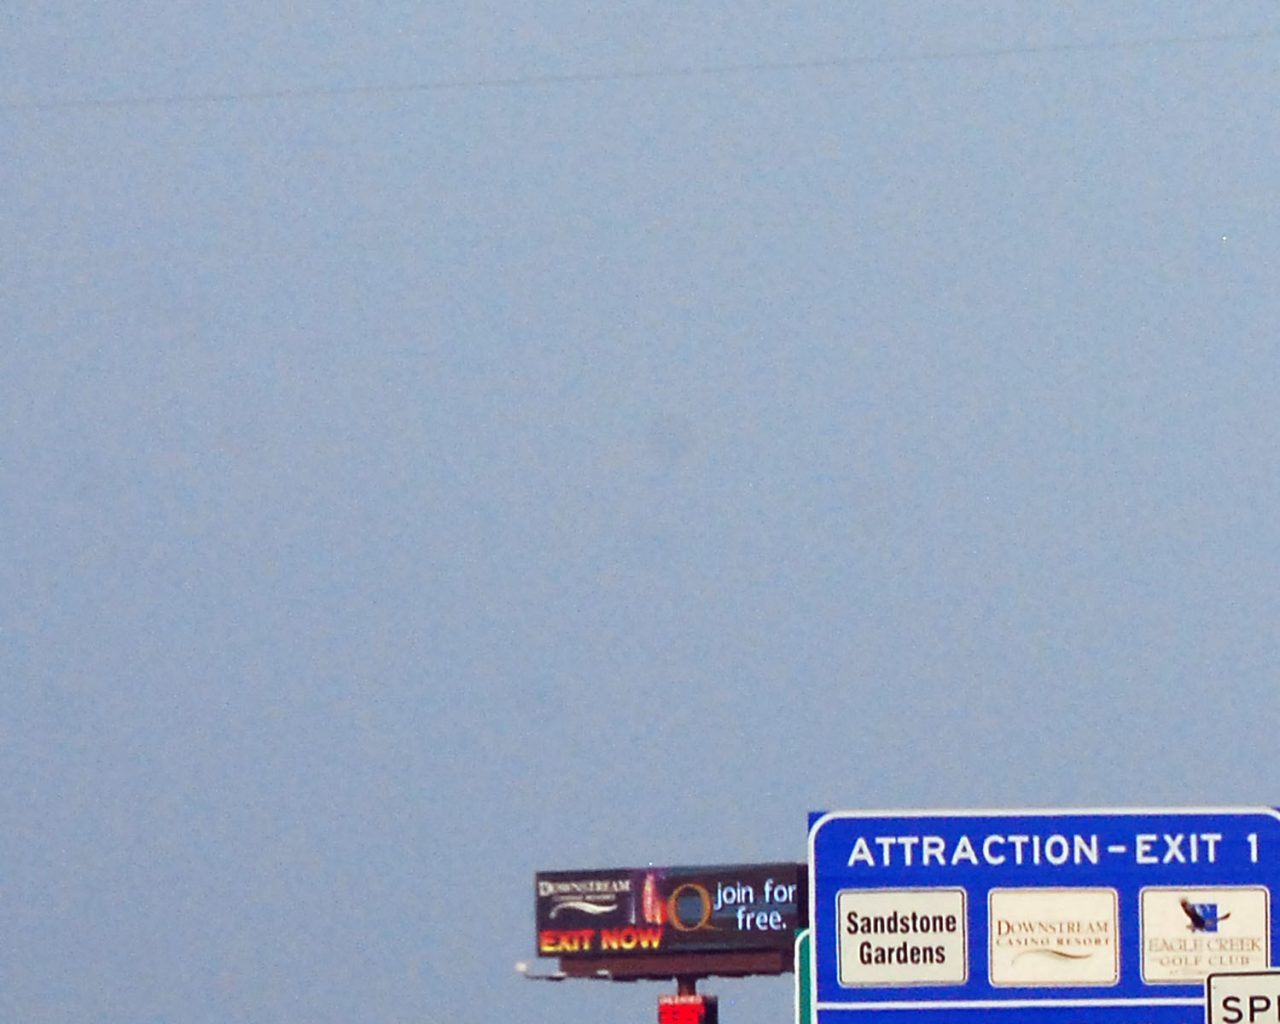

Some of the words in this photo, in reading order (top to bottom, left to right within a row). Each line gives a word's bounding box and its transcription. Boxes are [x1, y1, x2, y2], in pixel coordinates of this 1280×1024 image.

[1246, 833, 1259, 862] 1
[714, 882, 754, 910] join
[764, 879, 797, 902] for
[736, 910, 787, 931] free.
[846, 912, 957, 935] Sandstone
[996, 919, 1109, 937] DOWNSTREAM
[539, 929, 596, 953] EXIT
[600, 926, 665, 950] NOW
[1148, 938, 1202, 952] EAGLE
[1206, 937, 1262, 951] CREEK
[858, 943, 947, 966] Gardens
